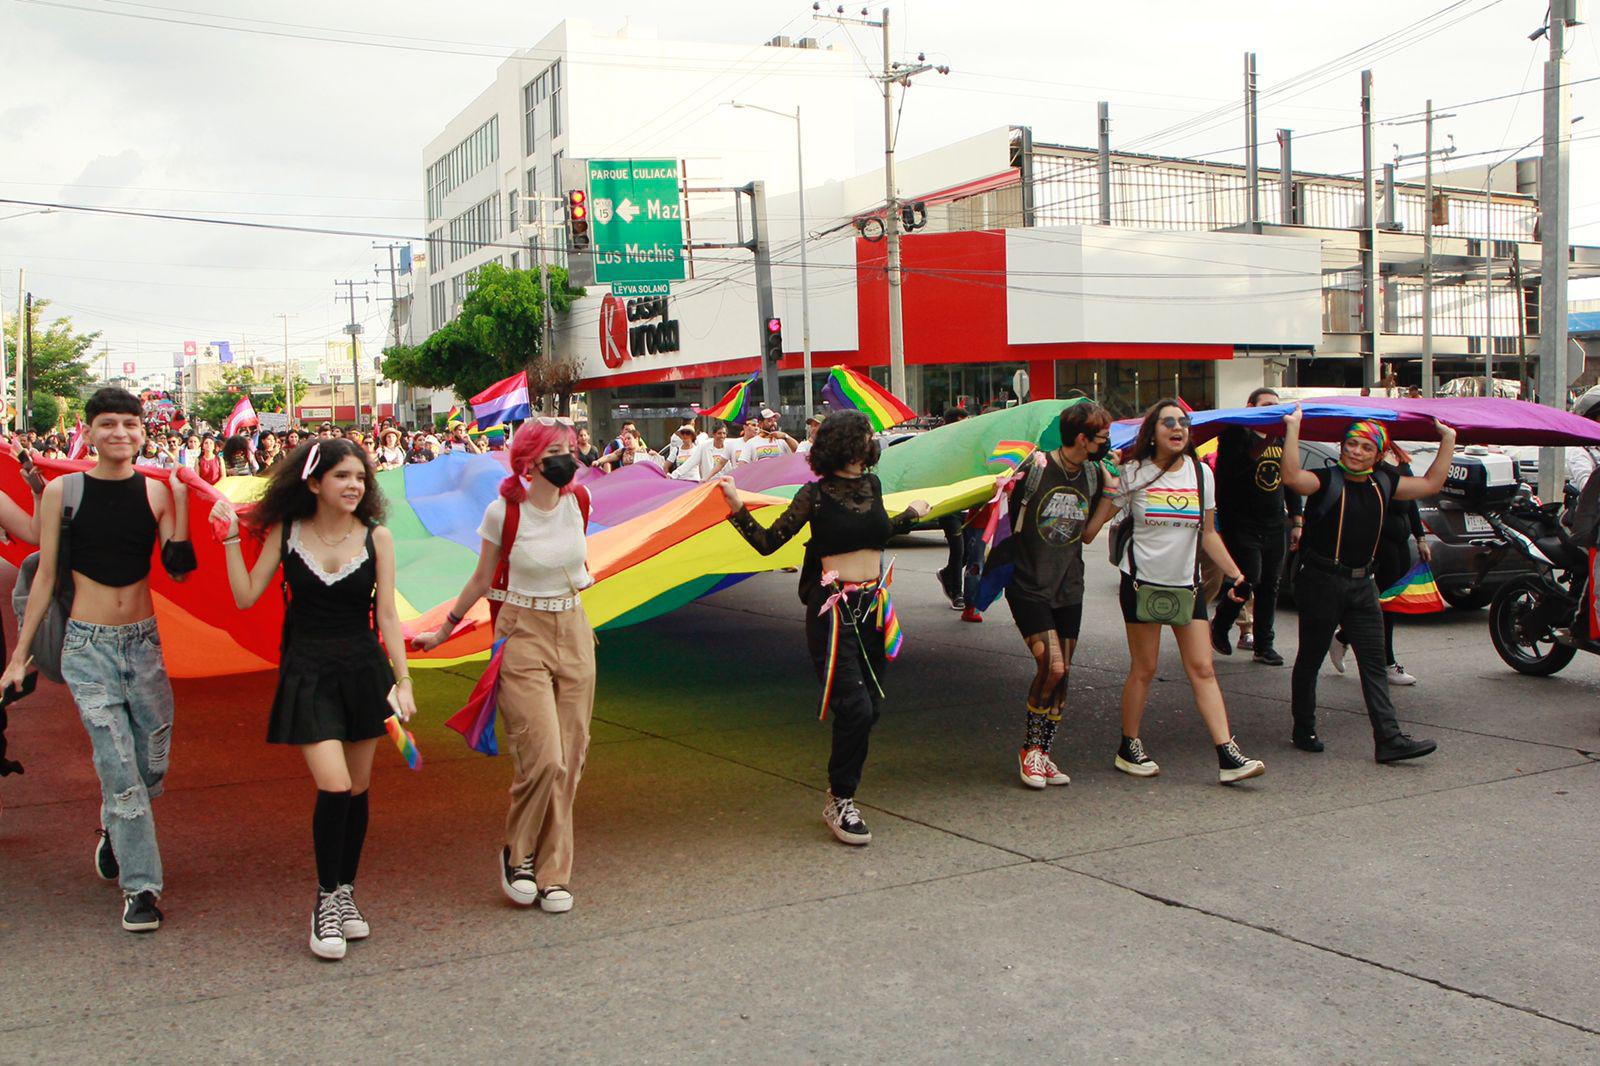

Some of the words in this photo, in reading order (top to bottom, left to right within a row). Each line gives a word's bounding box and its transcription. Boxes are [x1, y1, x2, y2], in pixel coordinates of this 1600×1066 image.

[591, 169, 628, 180] PARQUE
[599, 208, 609, 218] 15
[647, 199, 679, 219] Maz
[595, 244, 621, 264] Los
[626, 243, 675, 263] Mochis
[613, 284, 637, 294] LEYVA
[638, 284, 668, 293] SOLANO
[1144, 519, 1169, 527] LOVE
